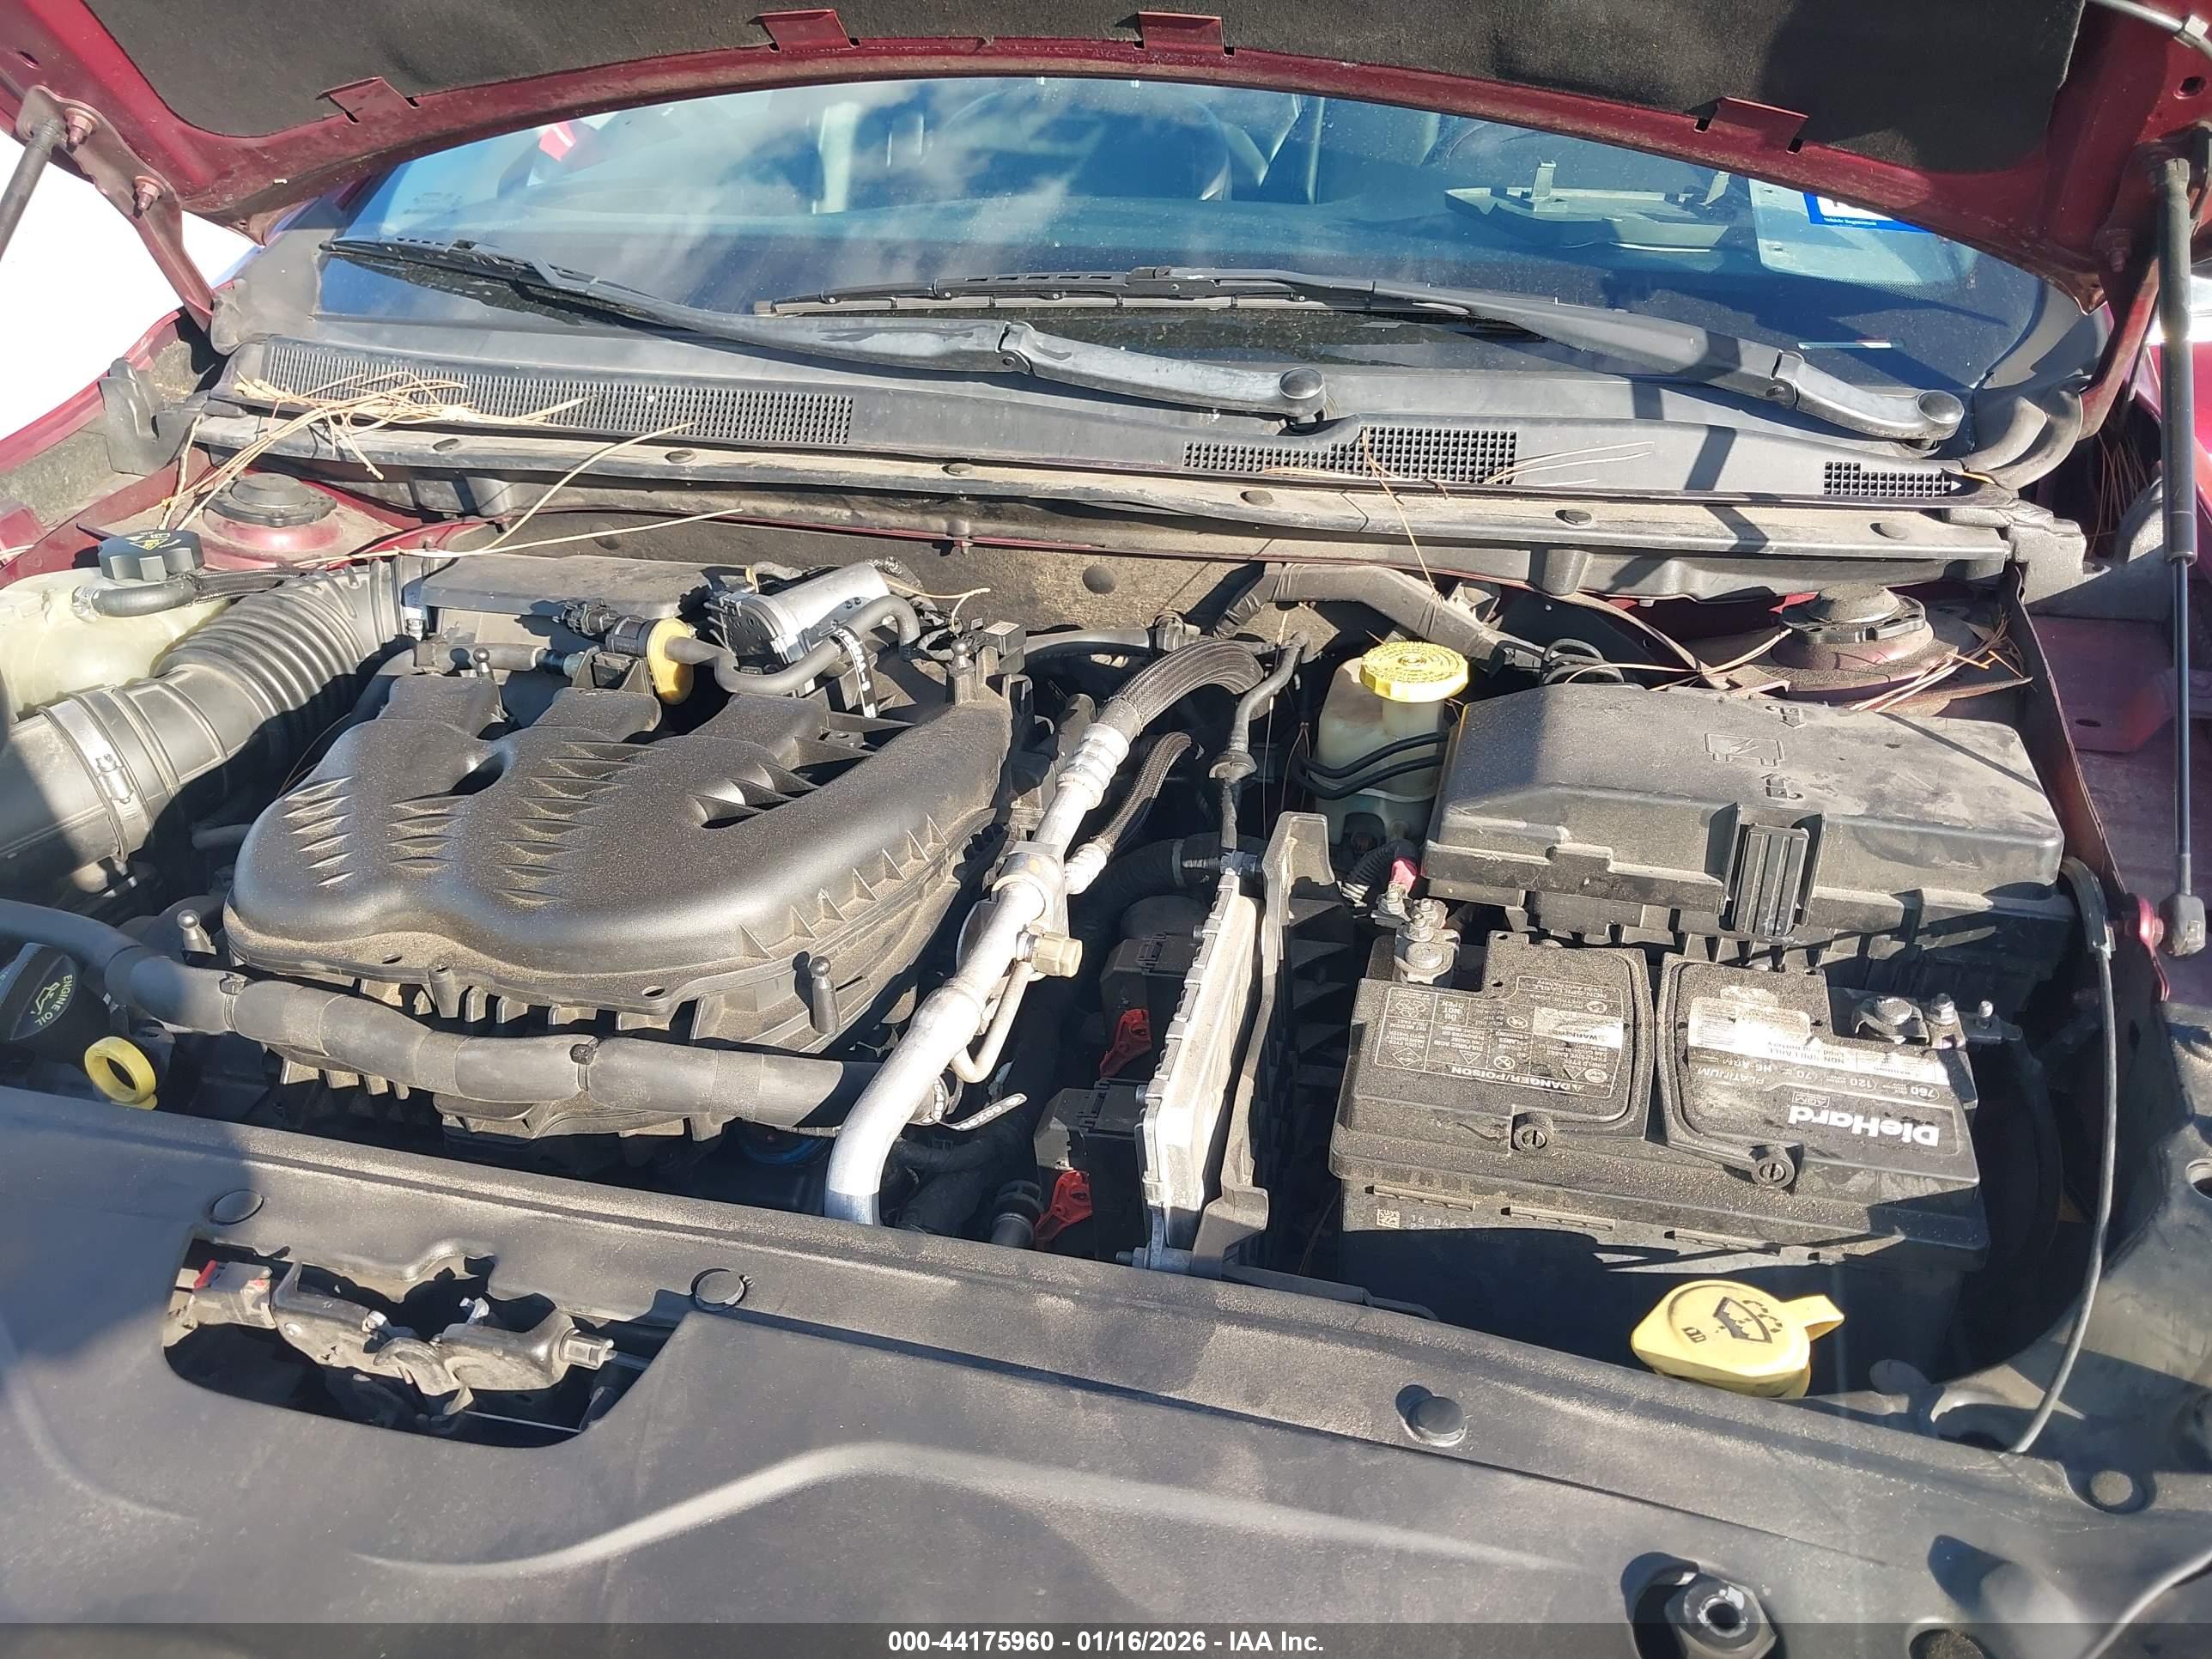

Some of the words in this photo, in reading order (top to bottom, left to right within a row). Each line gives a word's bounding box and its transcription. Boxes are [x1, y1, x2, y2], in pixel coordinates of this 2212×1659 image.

[51, 975, 72, 1012] ENGINE
[34, 1012, 53, 1026] OIL
[1450, 1066, 1571, 1090] DANGER/POISON
[1796, 1070, 1812, 1079] 70
[1849, 1077, 1870, 1087] 120
[1909, 1085, 1934, 1097] 760
[1789, 1105, 1939, 1147] DieHard
